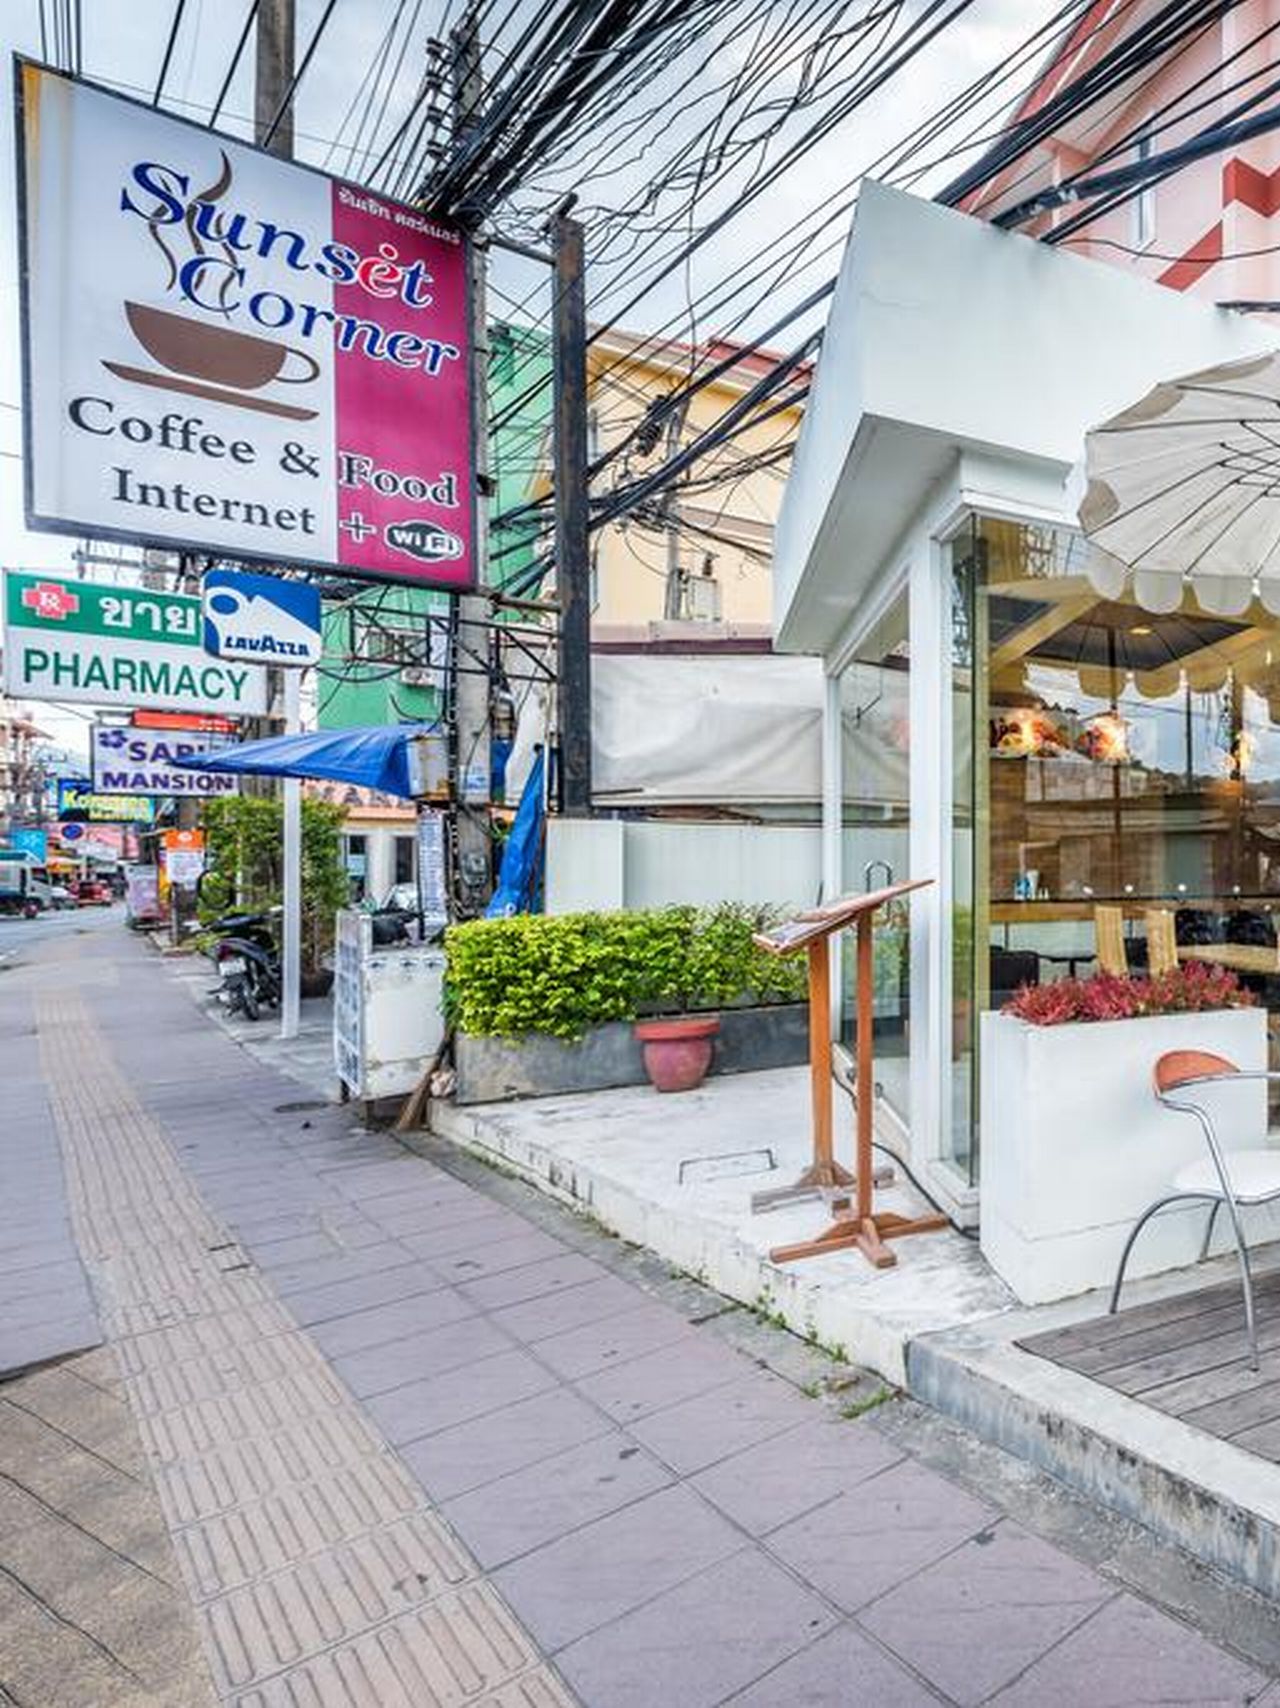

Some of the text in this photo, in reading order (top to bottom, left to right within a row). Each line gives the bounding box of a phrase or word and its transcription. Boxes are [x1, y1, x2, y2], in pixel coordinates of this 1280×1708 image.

[120, 163, 434, 308] Sunset
[179, 256, 460, 378] Corner
[68, 396, 460, 508] Coffee & Food
[112, 467, 316, 535] Internet
[99, 596, 201, 636] ขาย
[225, 634, 311, 657] LAVAZZA
[24, 648, 248, 701] PHARMACY
[102, 772, 234, 791] MANSION
